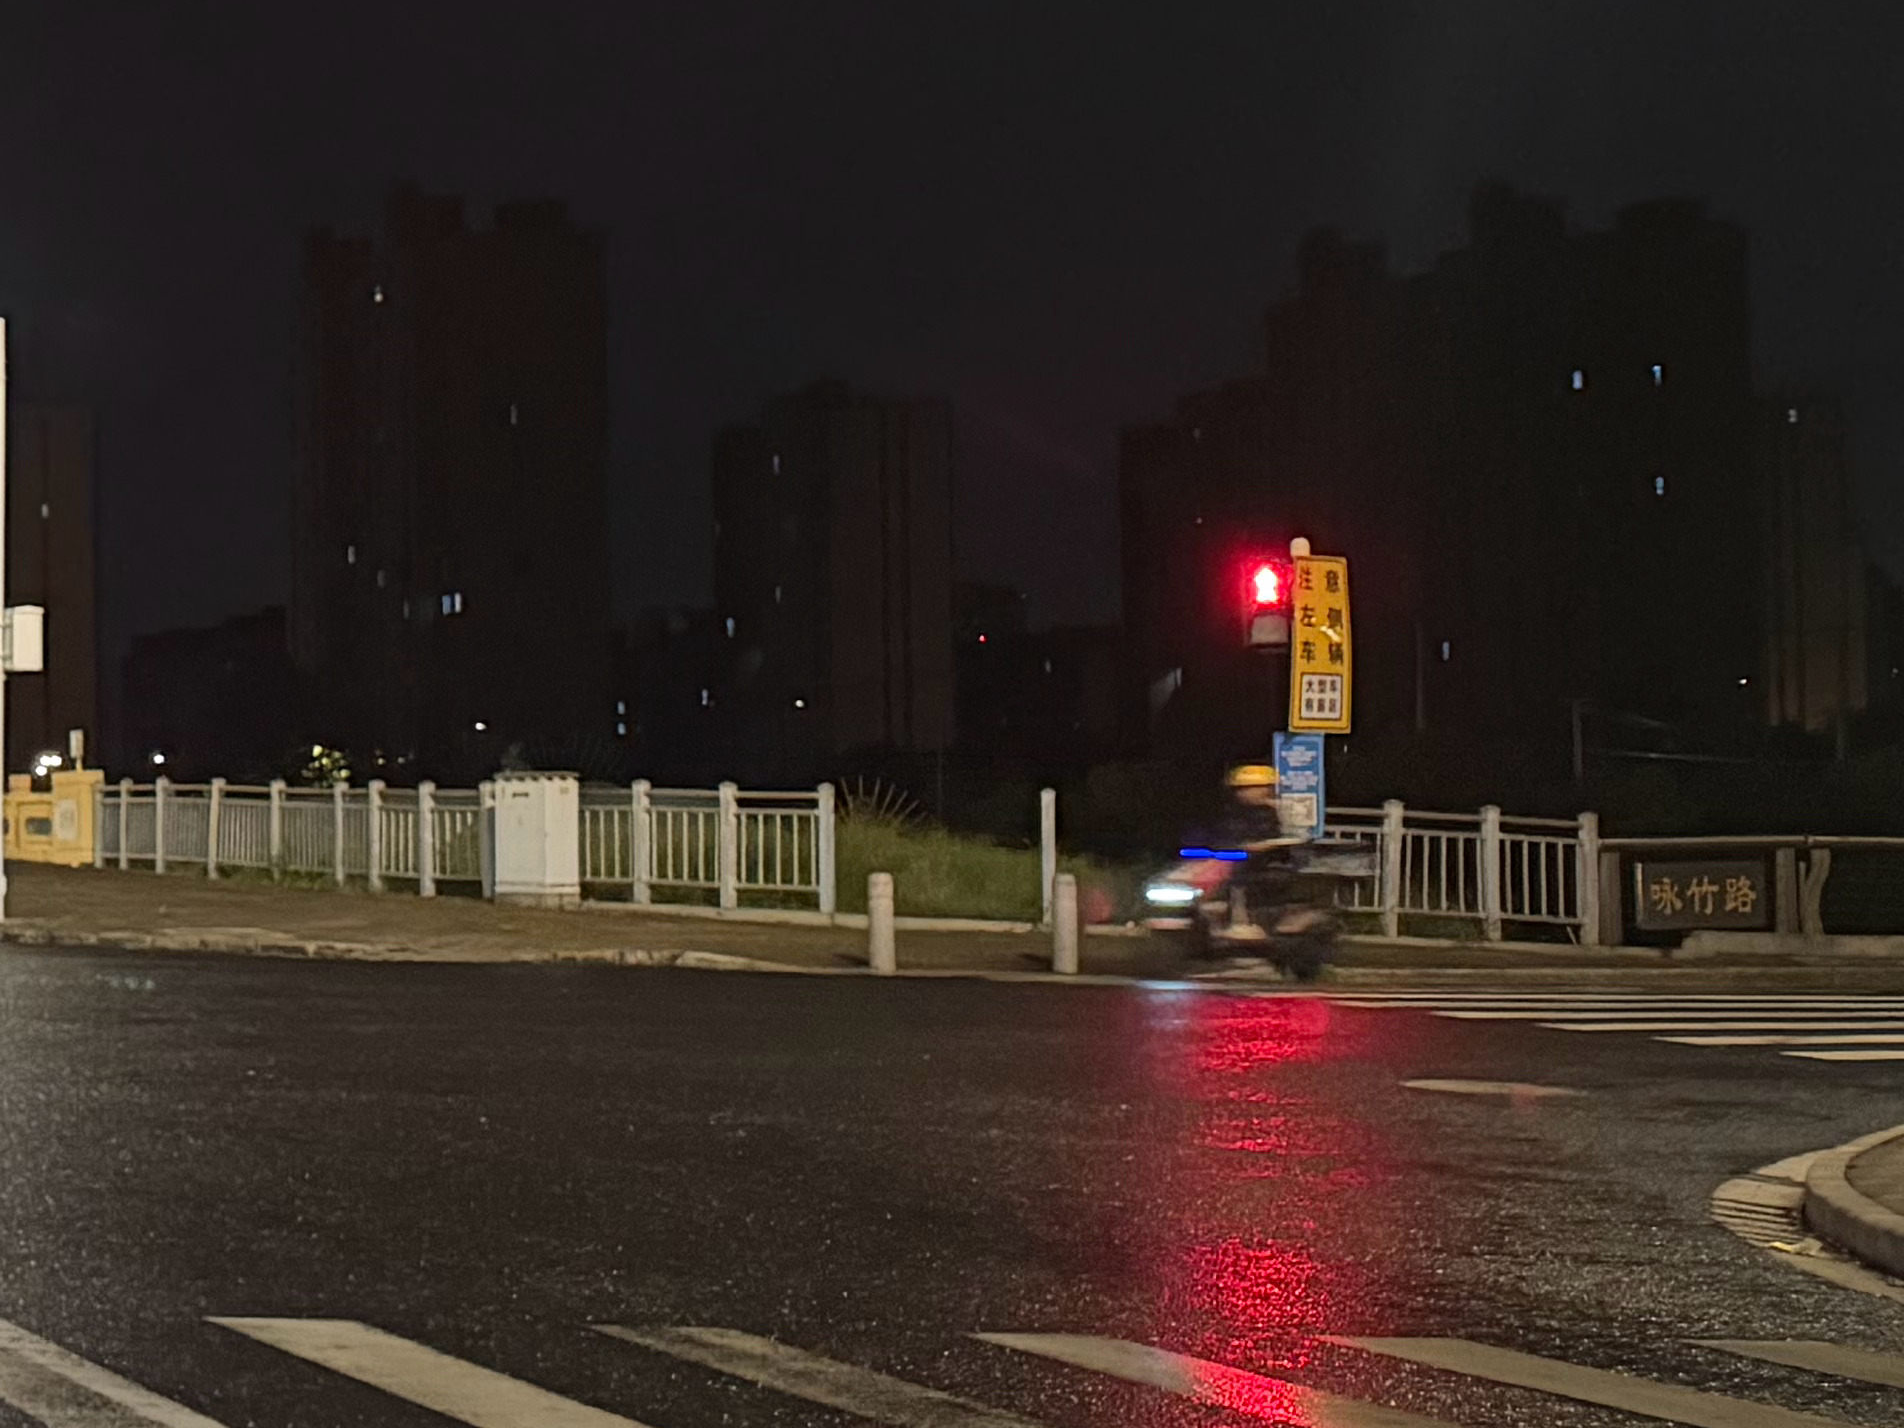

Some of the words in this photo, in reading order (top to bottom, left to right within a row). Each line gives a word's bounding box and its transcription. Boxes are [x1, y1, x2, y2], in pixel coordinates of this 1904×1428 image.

[1299, 565, 1341, 593] 注意
[1649, 875, 1758, 916] 咏竹路
